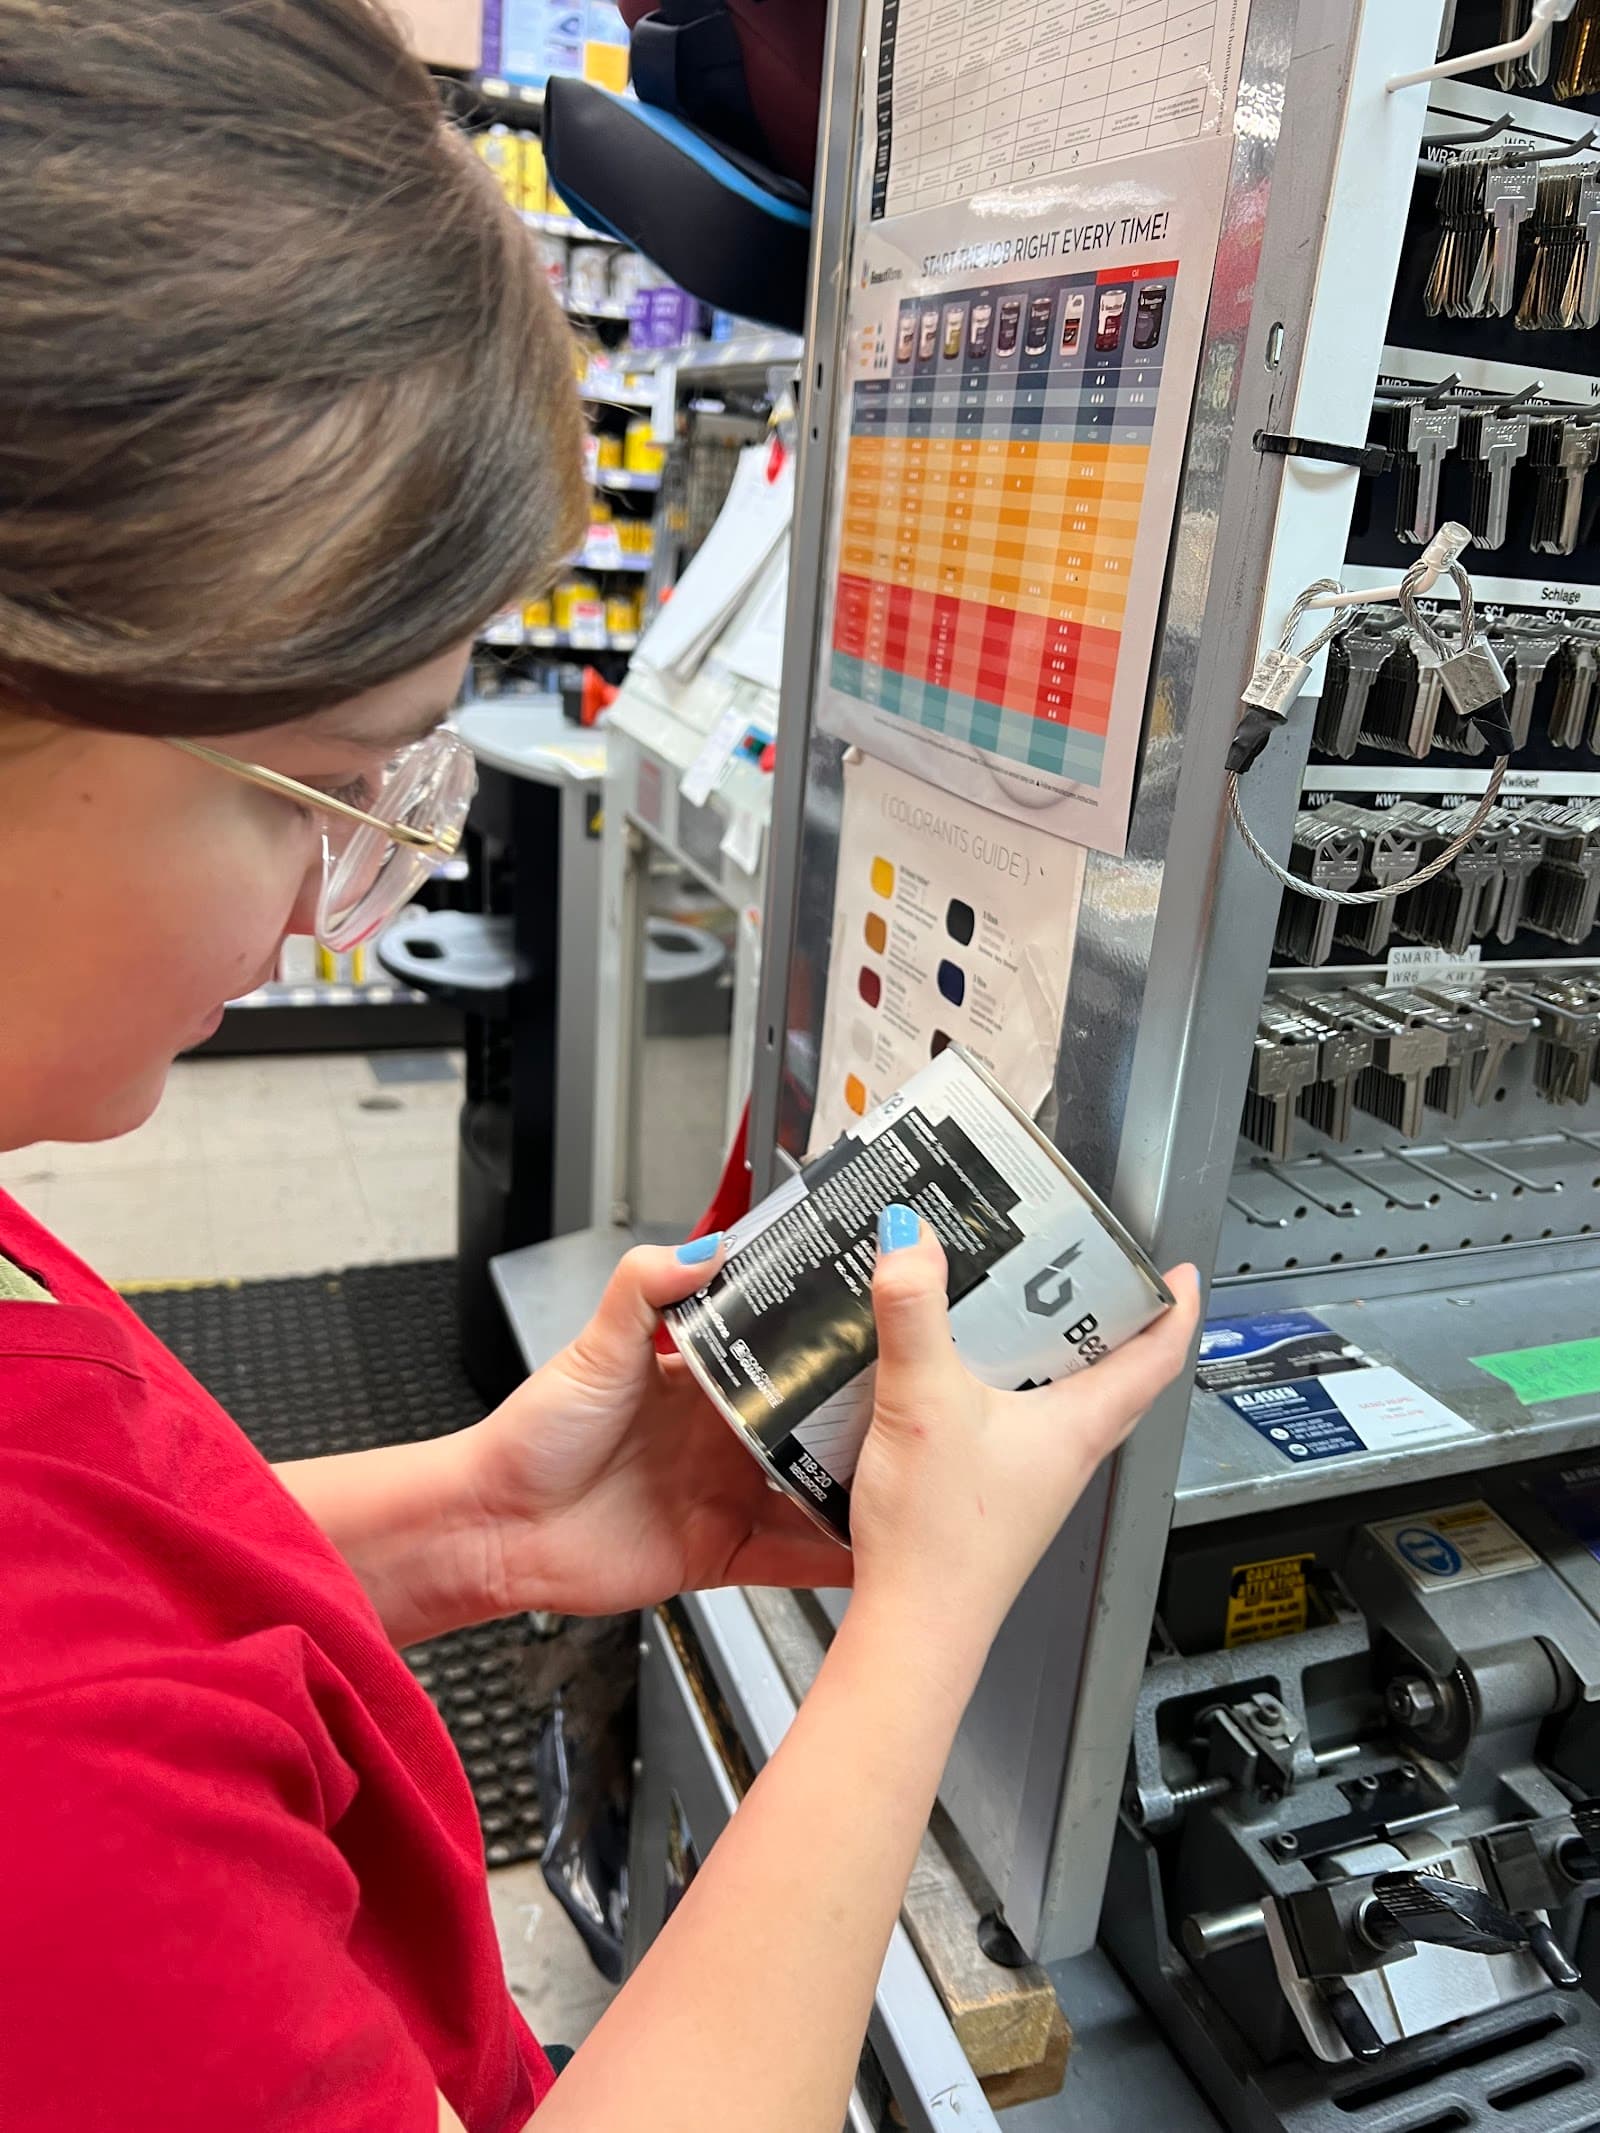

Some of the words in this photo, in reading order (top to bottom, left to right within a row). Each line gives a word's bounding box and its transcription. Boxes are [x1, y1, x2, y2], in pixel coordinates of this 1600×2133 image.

[921, 252, 957, 279] START
[956, 244, 984, 273] THE
[983, 239, 1012, 269] JOB
[1014, 231, 1061, 262] RIGHT
[1062, 220, 1116, 254] EVERY
[1121, 210, 1170, 246] TIME!
[1541, 587, 1582, 604] Schlage
[1416, 599, 1440, 615] SC1
[1483, 604, 1505, 620] SC1
[1545, 610, 1567, 624] SC1
[1499, 776, 1540, 790] Kwikset
[1307, 792, 1335, 807] KW1
[1374, 793, 1401, 808] KW1
[1441, 794, 1467, 808] KW1
[1501, 795, 1527, 809] KW1
[1567, 796, 1591, 809] KW1
[887, 796, 969, 854] COLORANTS
[972, 835, 1022, 879] GUIDE
[1392, 950, 1441, 965] SMART
[1233, 1384, 1301, 1409] KLASSEN
[797, 1451, 833, 1489] 118-20
